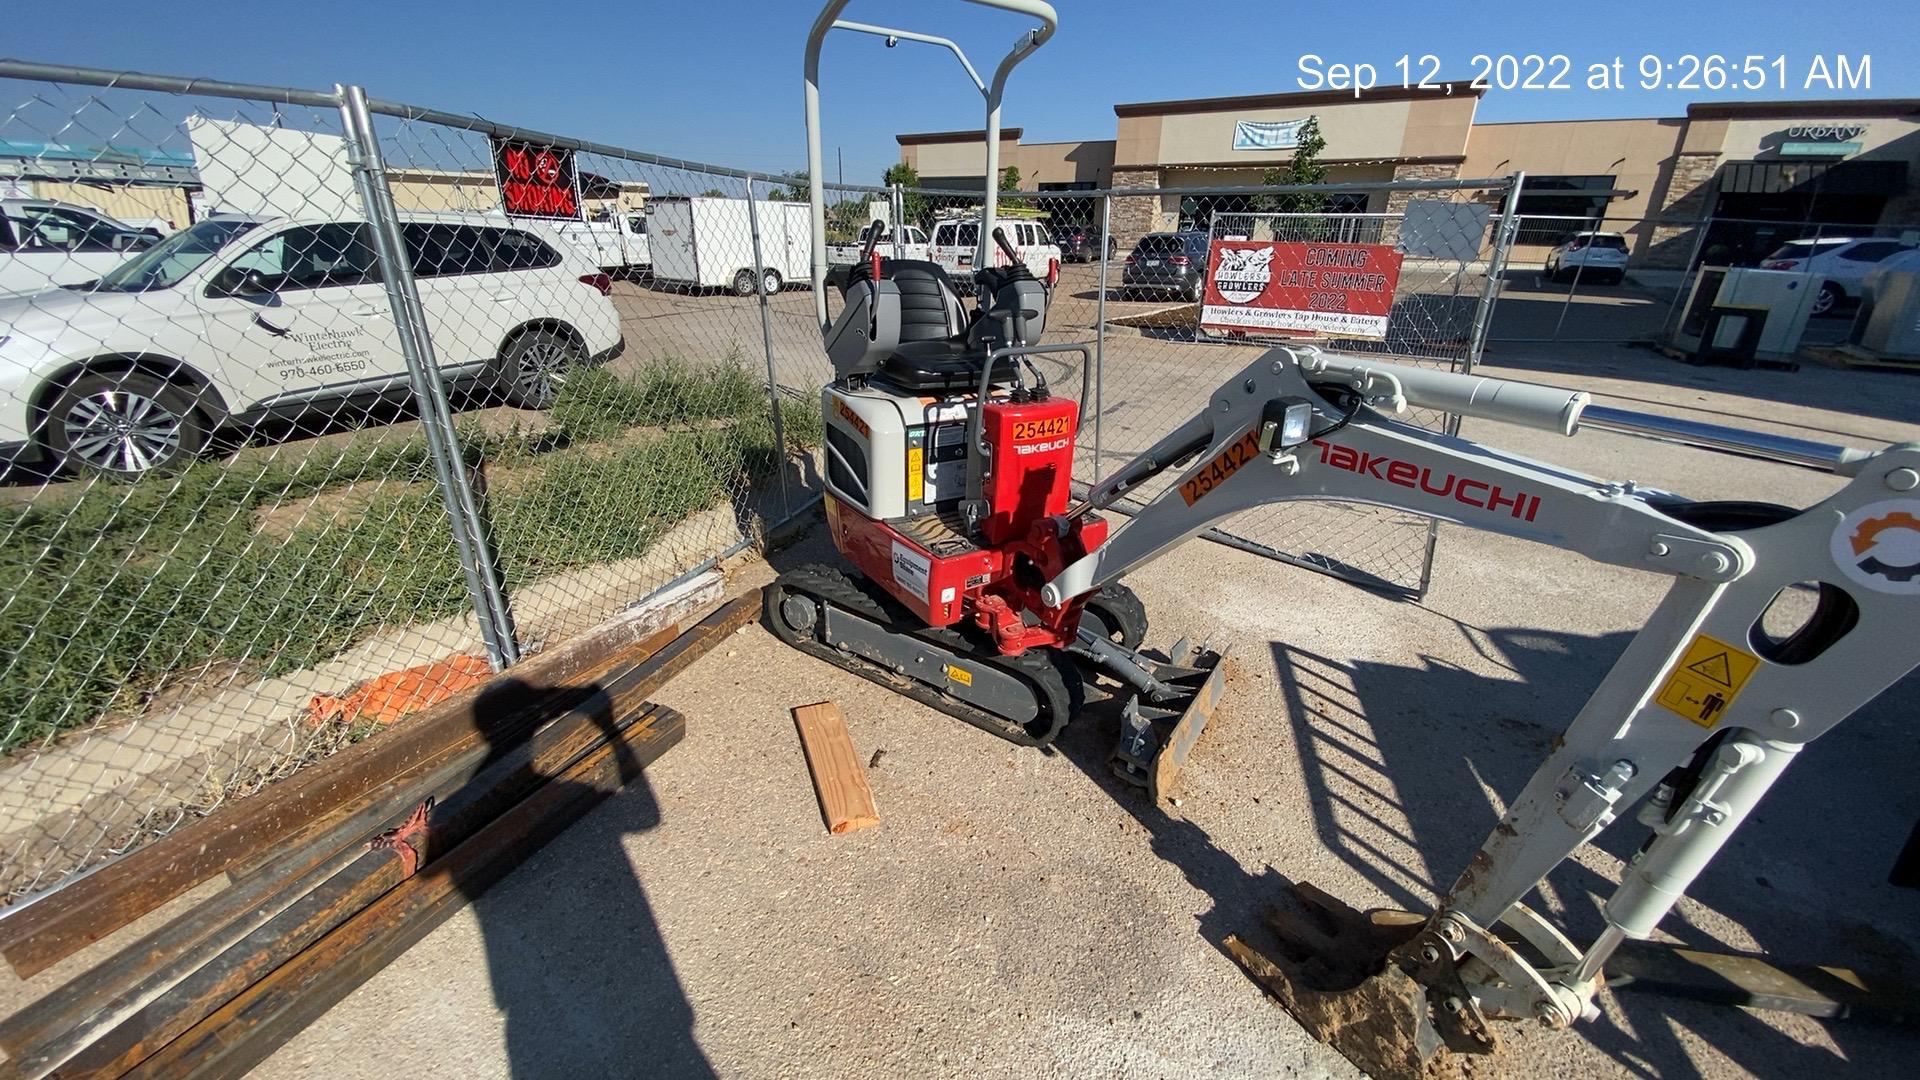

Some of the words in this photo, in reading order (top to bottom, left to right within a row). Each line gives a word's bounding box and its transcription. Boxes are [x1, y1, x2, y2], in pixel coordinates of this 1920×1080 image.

[1305, 247, 1368, 268] COMING
[1218, 271, 1261, 281] HOWLERS
[1280, 269, 1317, 288] LATE
[1321, 272, 1386, 292] SUMMER
[1217, 281, 1265, 292] GROWLERS
[1308, 292, 1347, 310] 2022
[1210, 308, 1243, 316] Howlers
[1254, 310, 1292, 320] Growlers
[1294, 312, 1310, 322] Tap
[1311, 313, 1339, 322] House
[1350, 316, 1381, 327] Eatery
[291, 327, 364, 343] Winterhawk
[309, 340, 353, 351] Electric
[280, 360, 366, 381] 970-460-6550
[1014, 417, 1069, 440] 254421
[1186, 432, 1261, 502] 254421
[1312, 439, 1541, 523] TAKEUCHI
